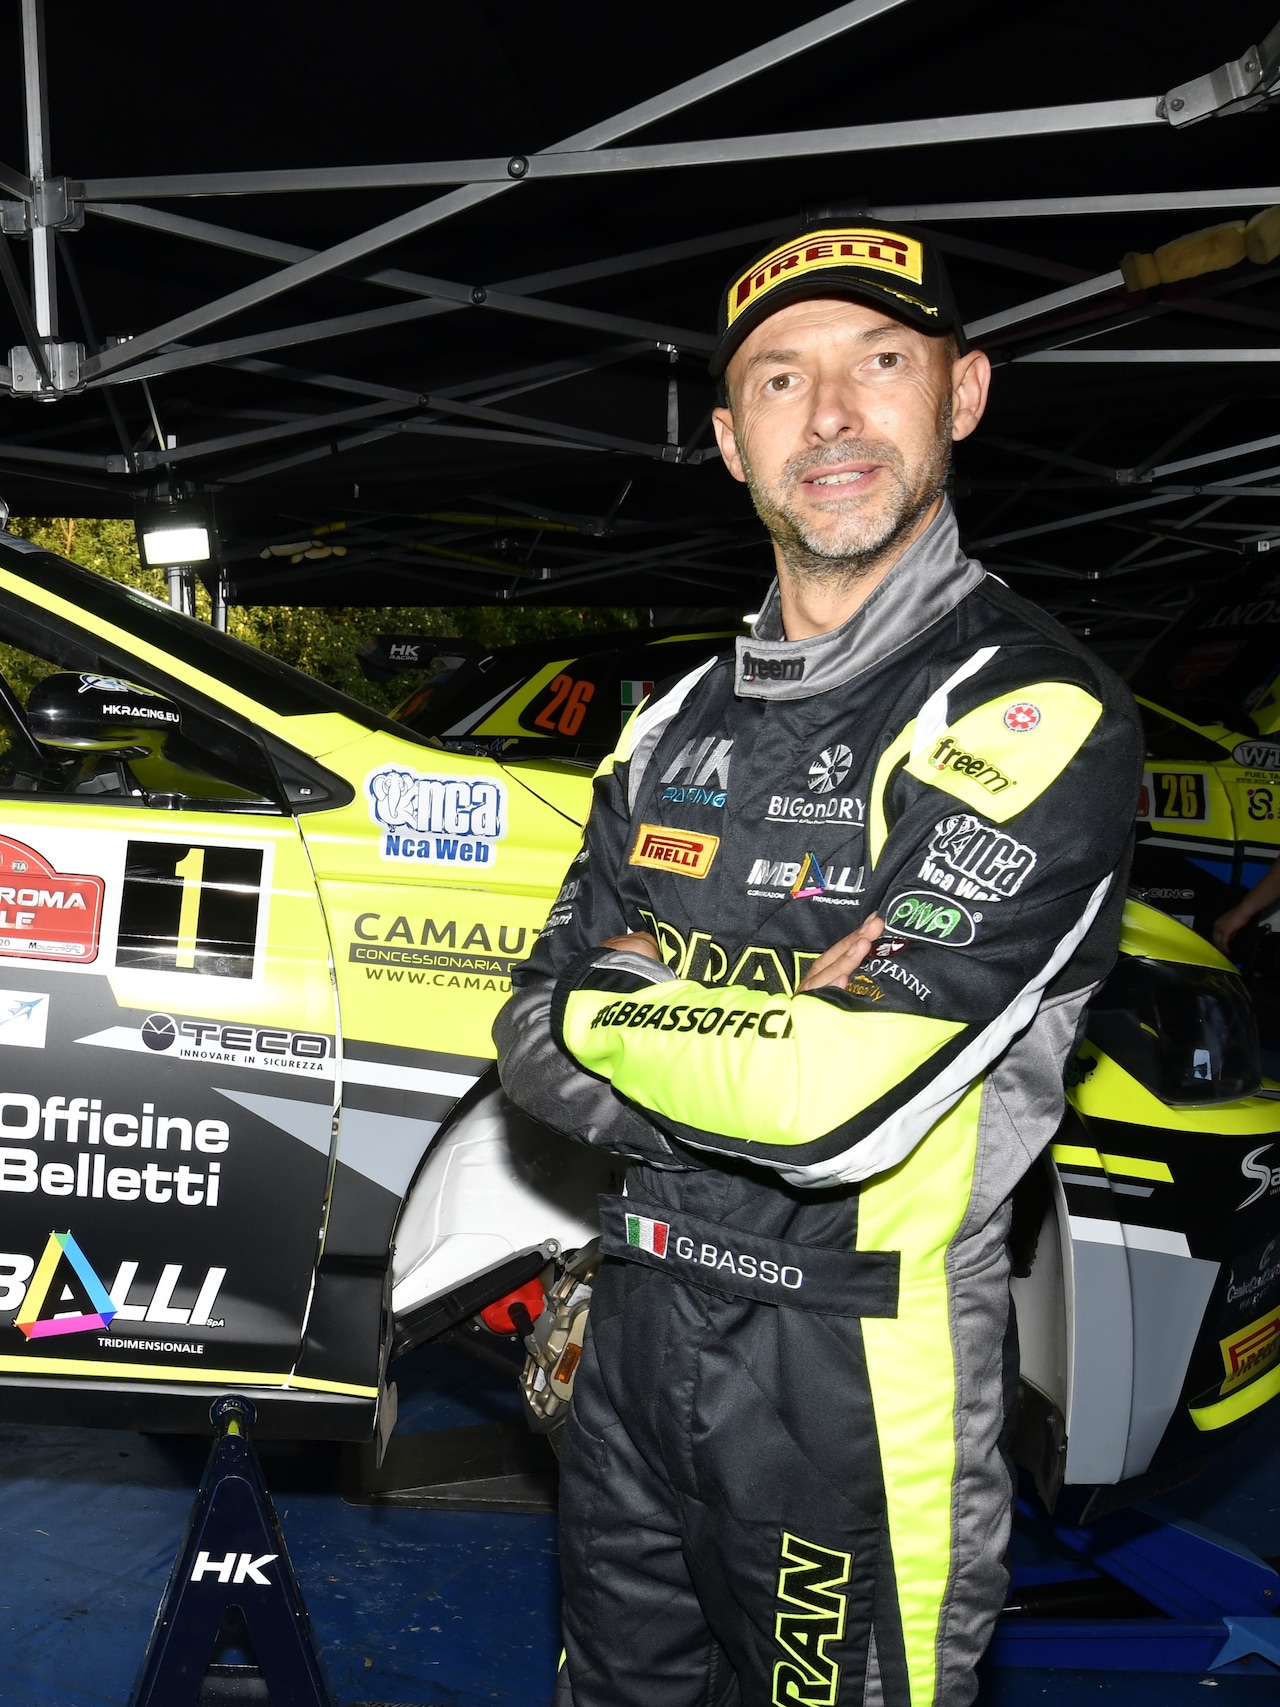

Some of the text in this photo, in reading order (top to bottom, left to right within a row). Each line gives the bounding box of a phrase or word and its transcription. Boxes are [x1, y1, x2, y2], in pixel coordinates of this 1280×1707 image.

[736, 234, 908, 308] PIRELLI
[390, 644, 420, 656] HK
[743, 651, 806, 681] freem
[102, 704, 180, 723] HKRACING.EU
[534, 674, 596, 736] 26
[660, 736, 734, 791] HK
[930, 736, 1013, 795] freem
[1161, 775, 1198, 818] 26
[385, 835, 490, 863] Nca Web
[640, 834, 704, 867] PIRELLI
[918, 857, 958, 891] Nca
[174, 848, 205, 968] 1
[356, 948, 502, 972] CONCESSIONARIA
[365, 967, 512, 993] WWW.CAMAU
[181, 1022, 330, 1059] TECO
[180, 1048, 324, 1071] INNOVARE IN SICUREZZA
[676, 1236, 803, 1290] G.BASSO
[206, 1317, 225, 1328] SpA
[97, 1337, 204, 1354] TRIDIMENSIONALE
[190, 1551, 280, 1585] HK
